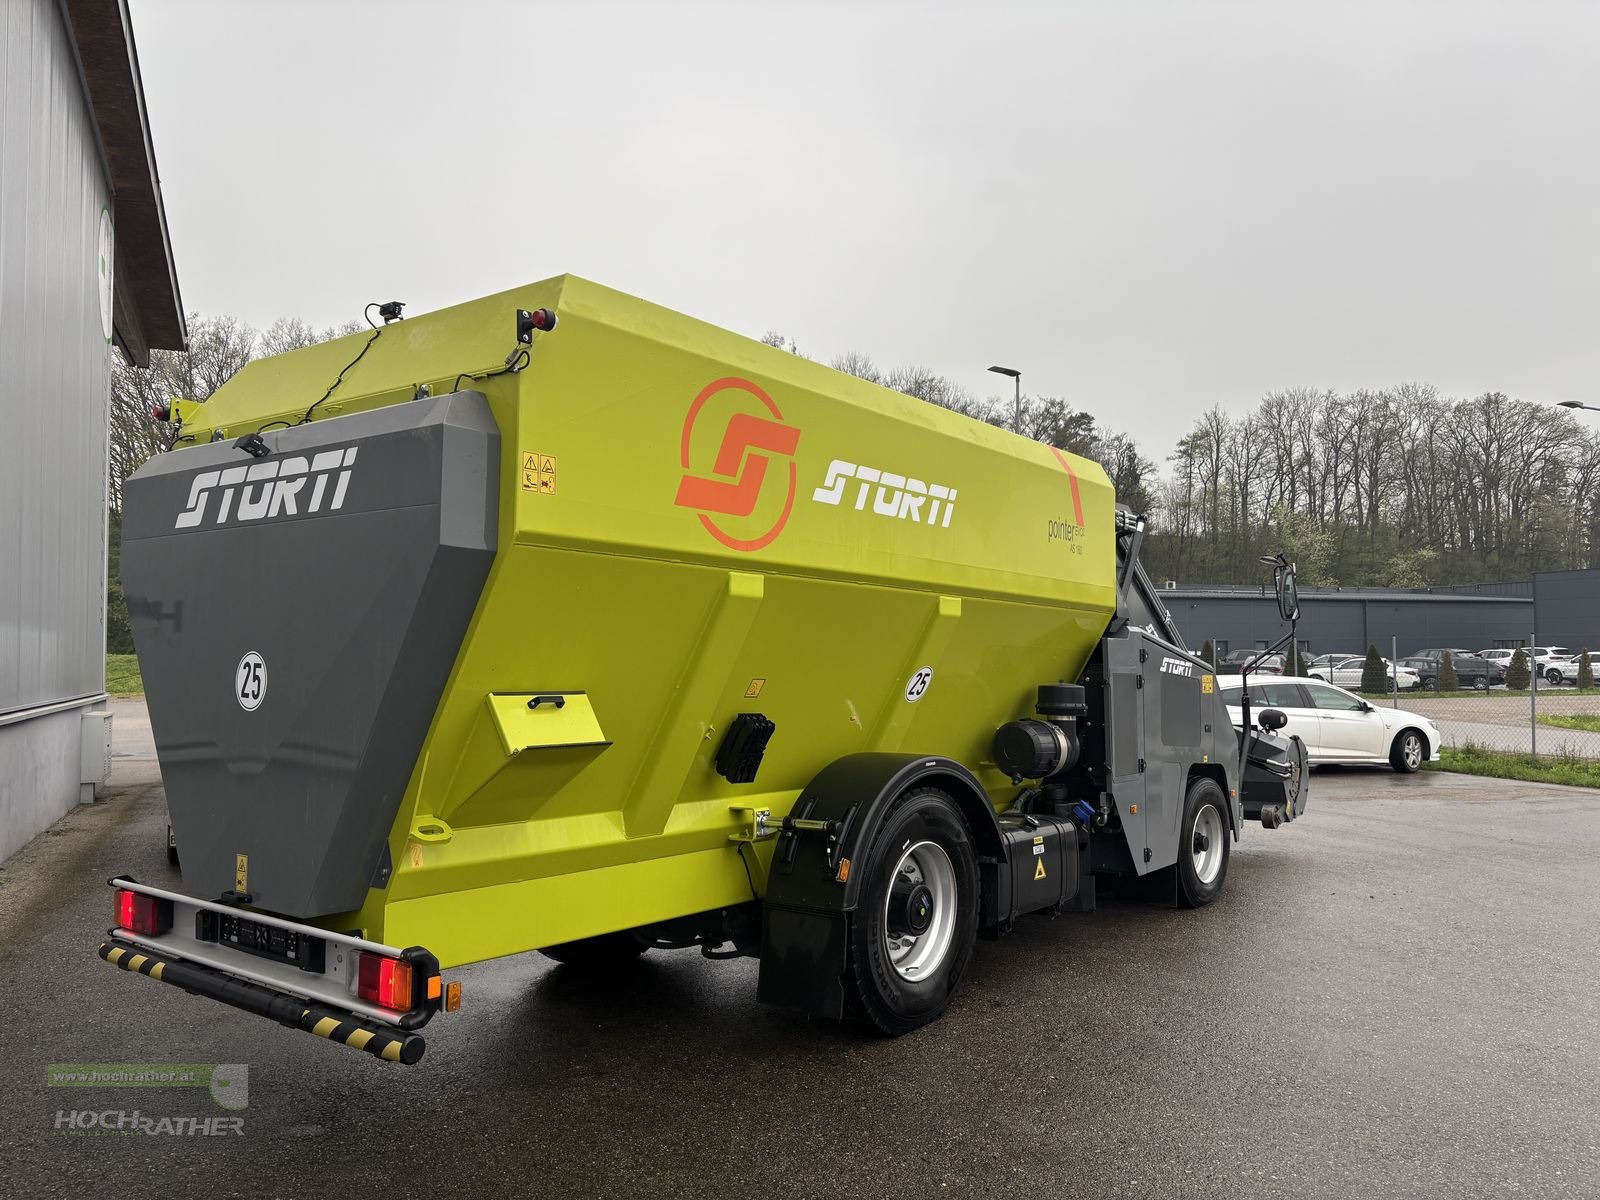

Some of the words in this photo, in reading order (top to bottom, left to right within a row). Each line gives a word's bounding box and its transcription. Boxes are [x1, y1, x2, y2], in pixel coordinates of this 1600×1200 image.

[1048, 515, 1075, 543] pointer
[241, 661, 262, 700] 25
[908, 672, 931, 696] 25
